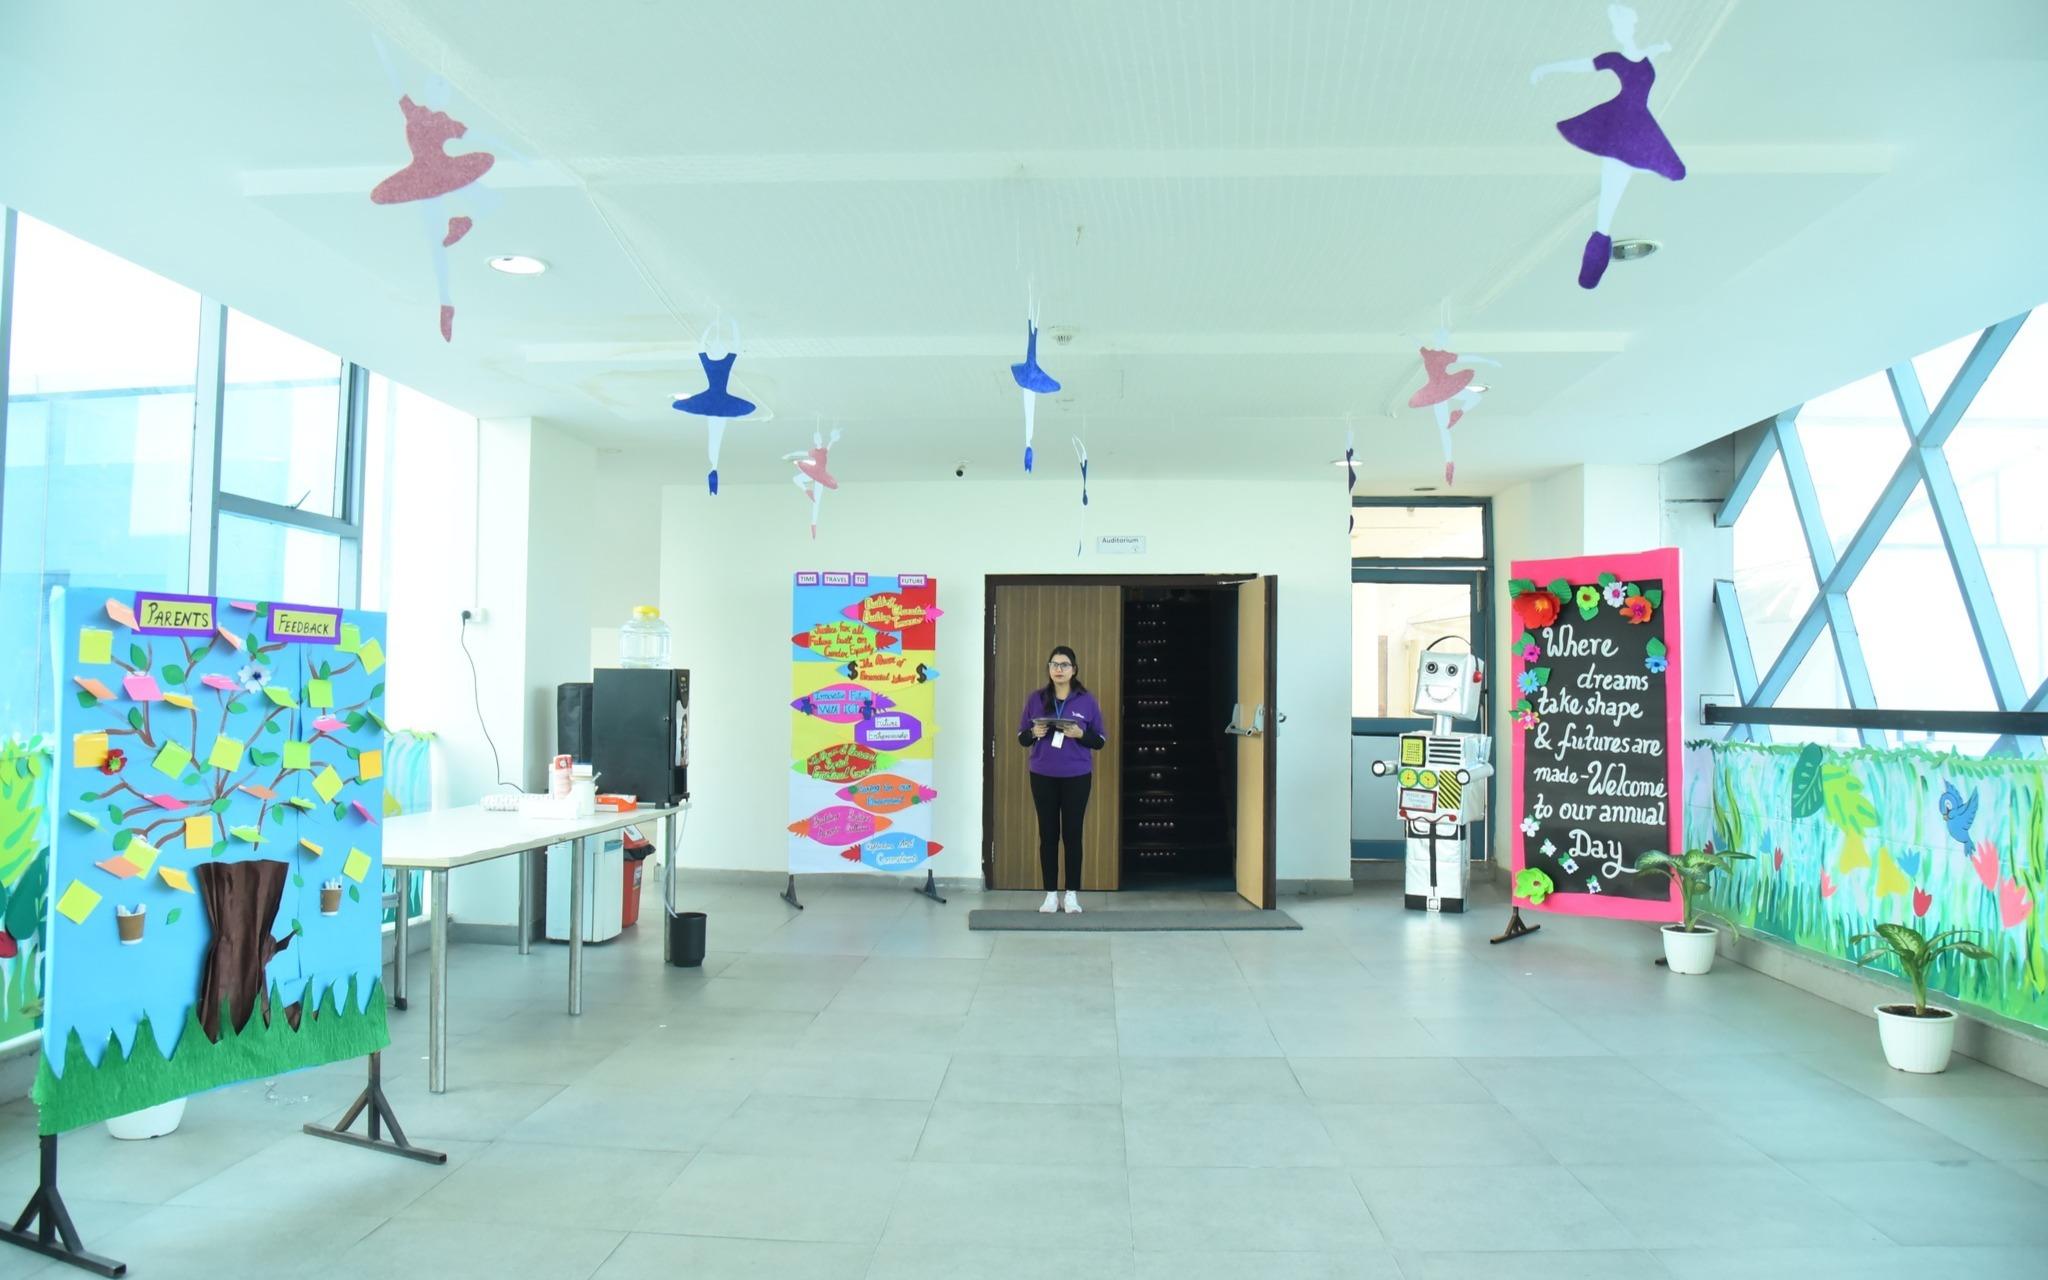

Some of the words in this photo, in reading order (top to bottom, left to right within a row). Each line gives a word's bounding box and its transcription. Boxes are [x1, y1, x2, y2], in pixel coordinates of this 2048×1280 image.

[901, 577, 923, 585] FUTURE
[148, 602, 210, 628] PARENTS
[279, 614, 329, 635] FEEDBACK
[852, 624, 864, 635] all
[1542, 624, 1619, 658] Where
[1577, 662, 1649, 691] dreams
[1537, 686, 1583, 715] take
[1585, 691, 1644, 727] shape
[1534, 722, 1553, 750] &
[1554, 722, 1630, 761] futures
[1631, 739, 1664, 757] are
[1533, 793, 1553, 820] to
[1559, 802, 1597, 821] our
[1599, 801, 1666, 826] annual
[1568, 829, 1640, 879] Day
